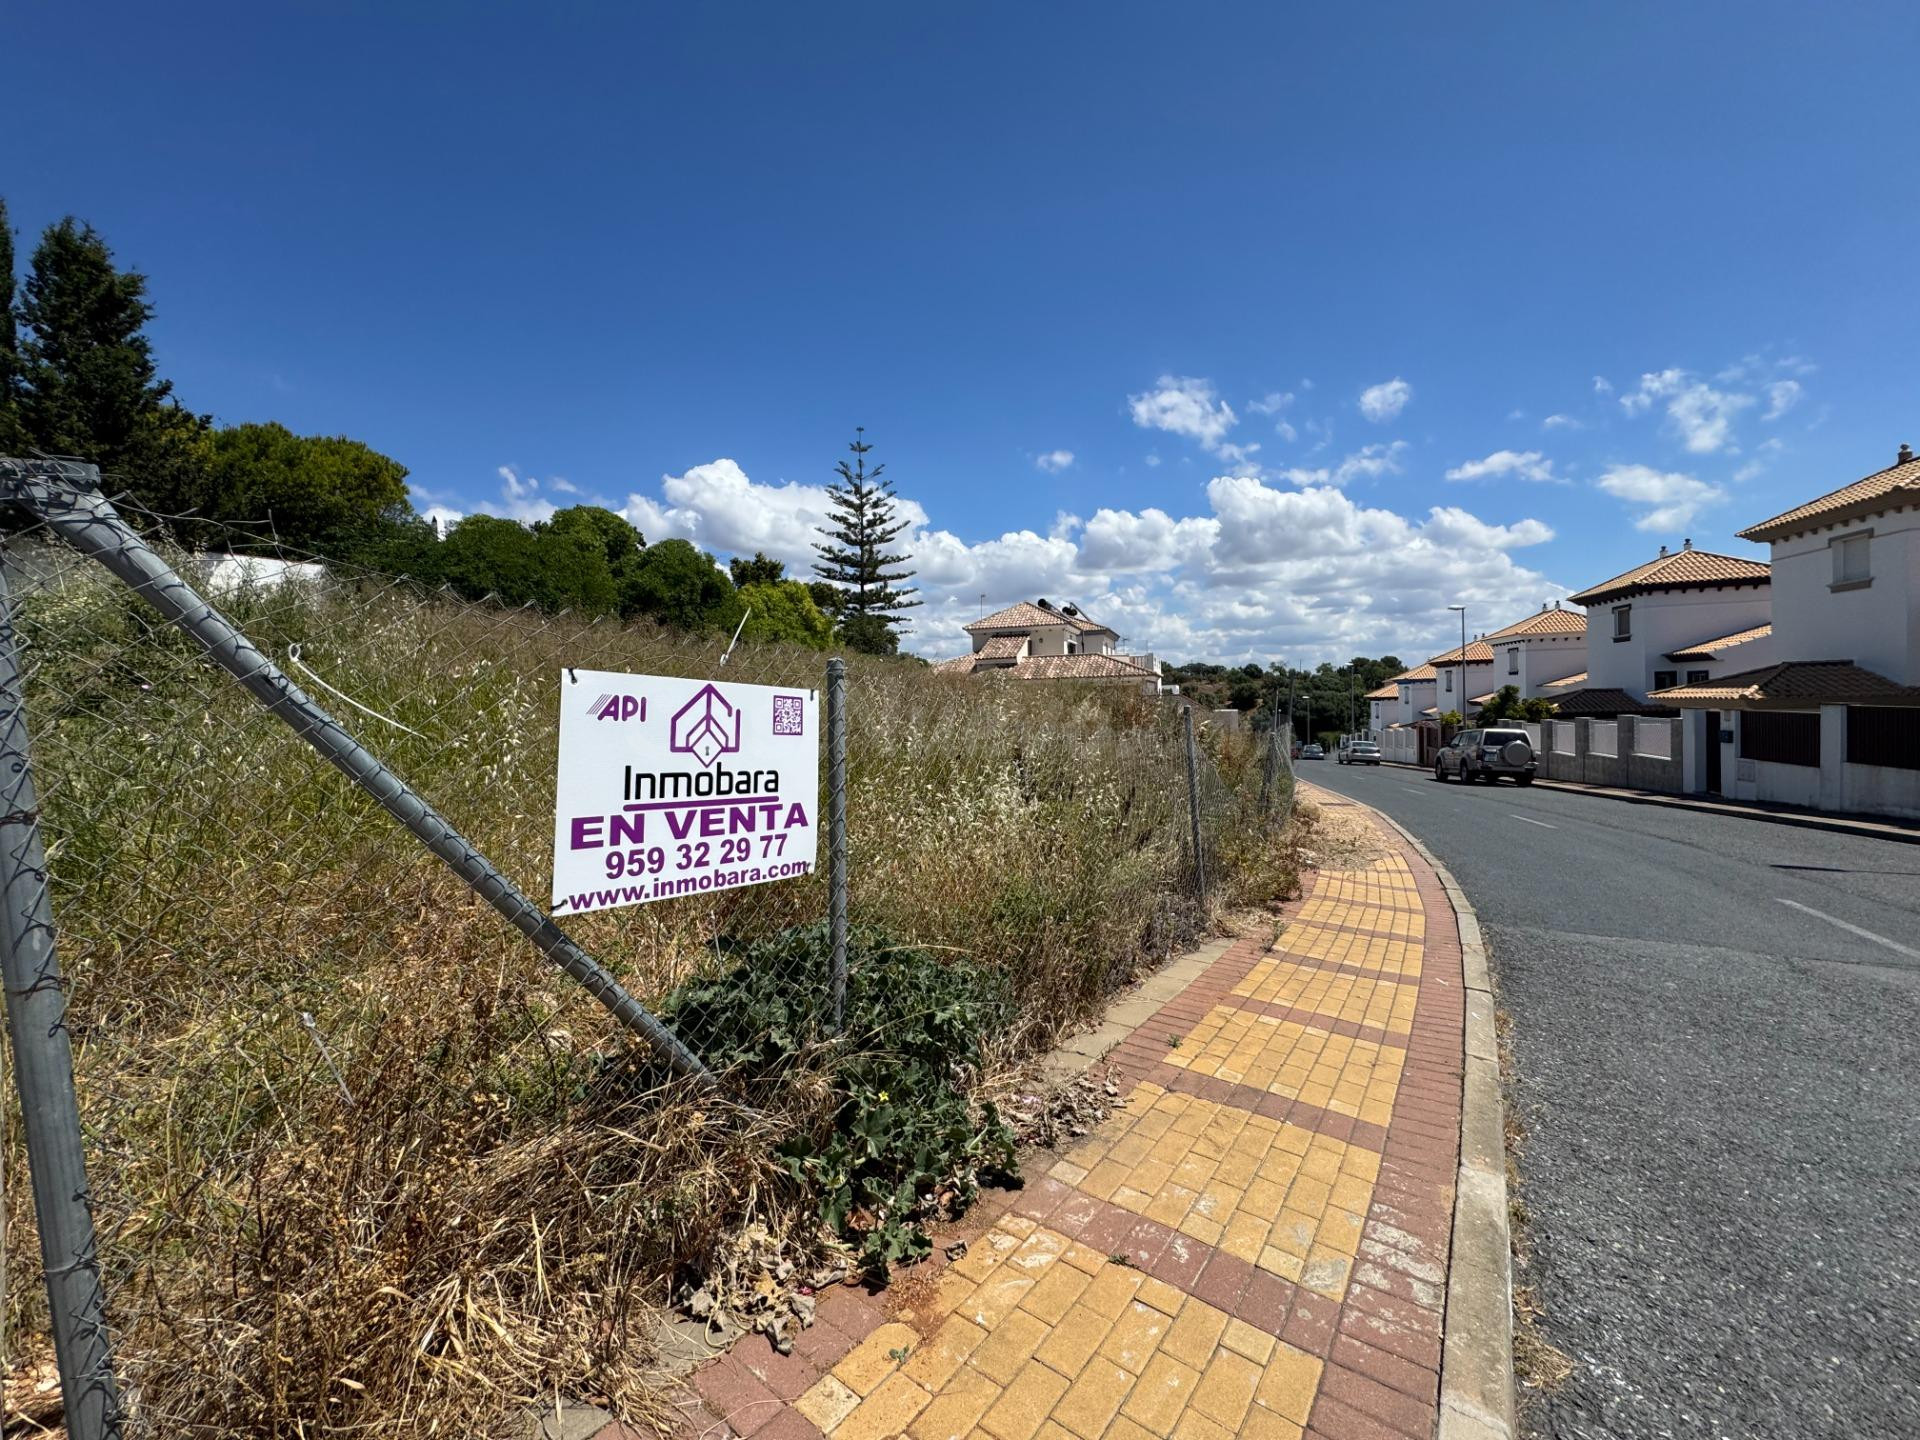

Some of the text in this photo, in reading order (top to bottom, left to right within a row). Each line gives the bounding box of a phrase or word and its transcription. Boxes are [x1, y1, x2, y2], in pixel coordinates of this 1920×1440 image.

[598, 695, 647, 722] API
[624, 762, 779, 800] Inmobara
[571, 803, 808, 850] EN VENTA
[605, 834, 788, 879] 959 32 29 77
[569, 861, 807, 910] www.inmobara.com
